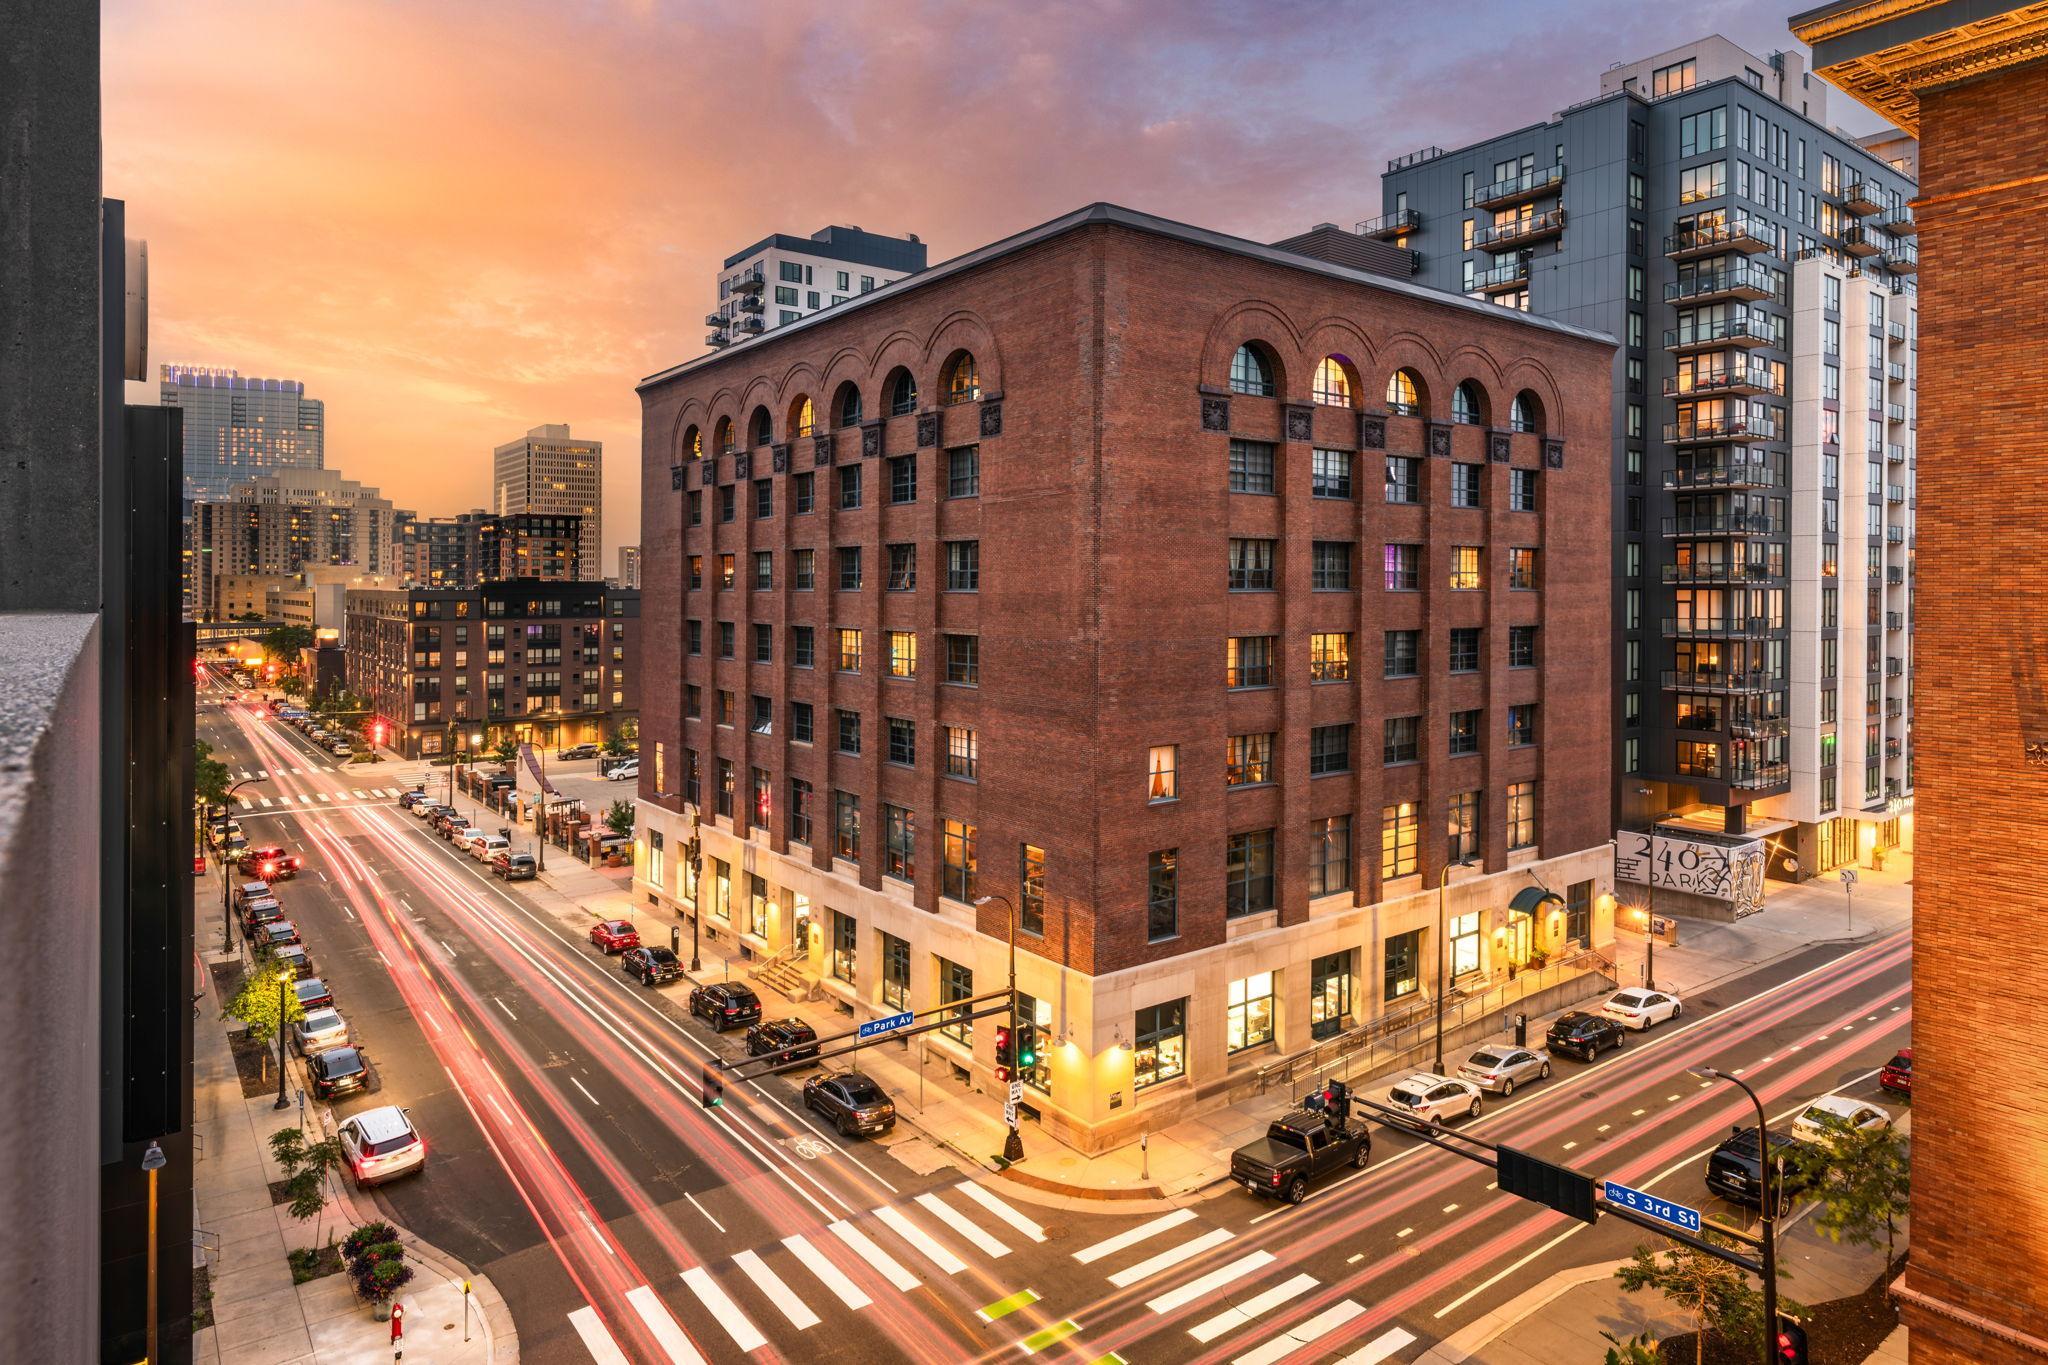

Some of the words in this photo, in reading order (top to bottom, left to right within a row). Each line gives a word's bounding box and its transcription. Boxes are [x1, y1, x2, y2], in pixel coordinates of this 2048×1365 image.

[1634, 836, 1700, 872] 240
[1650, 872, 1709, 889] PARK
[873, 1019, 896, 1032] Park
[899, 1015, 912, 1025] Av
[1627, 1192, 1636, 1205] S
[1644, 1198, 1671, 1218] 3rd
[1678, 1211, 1696, 1226] St
